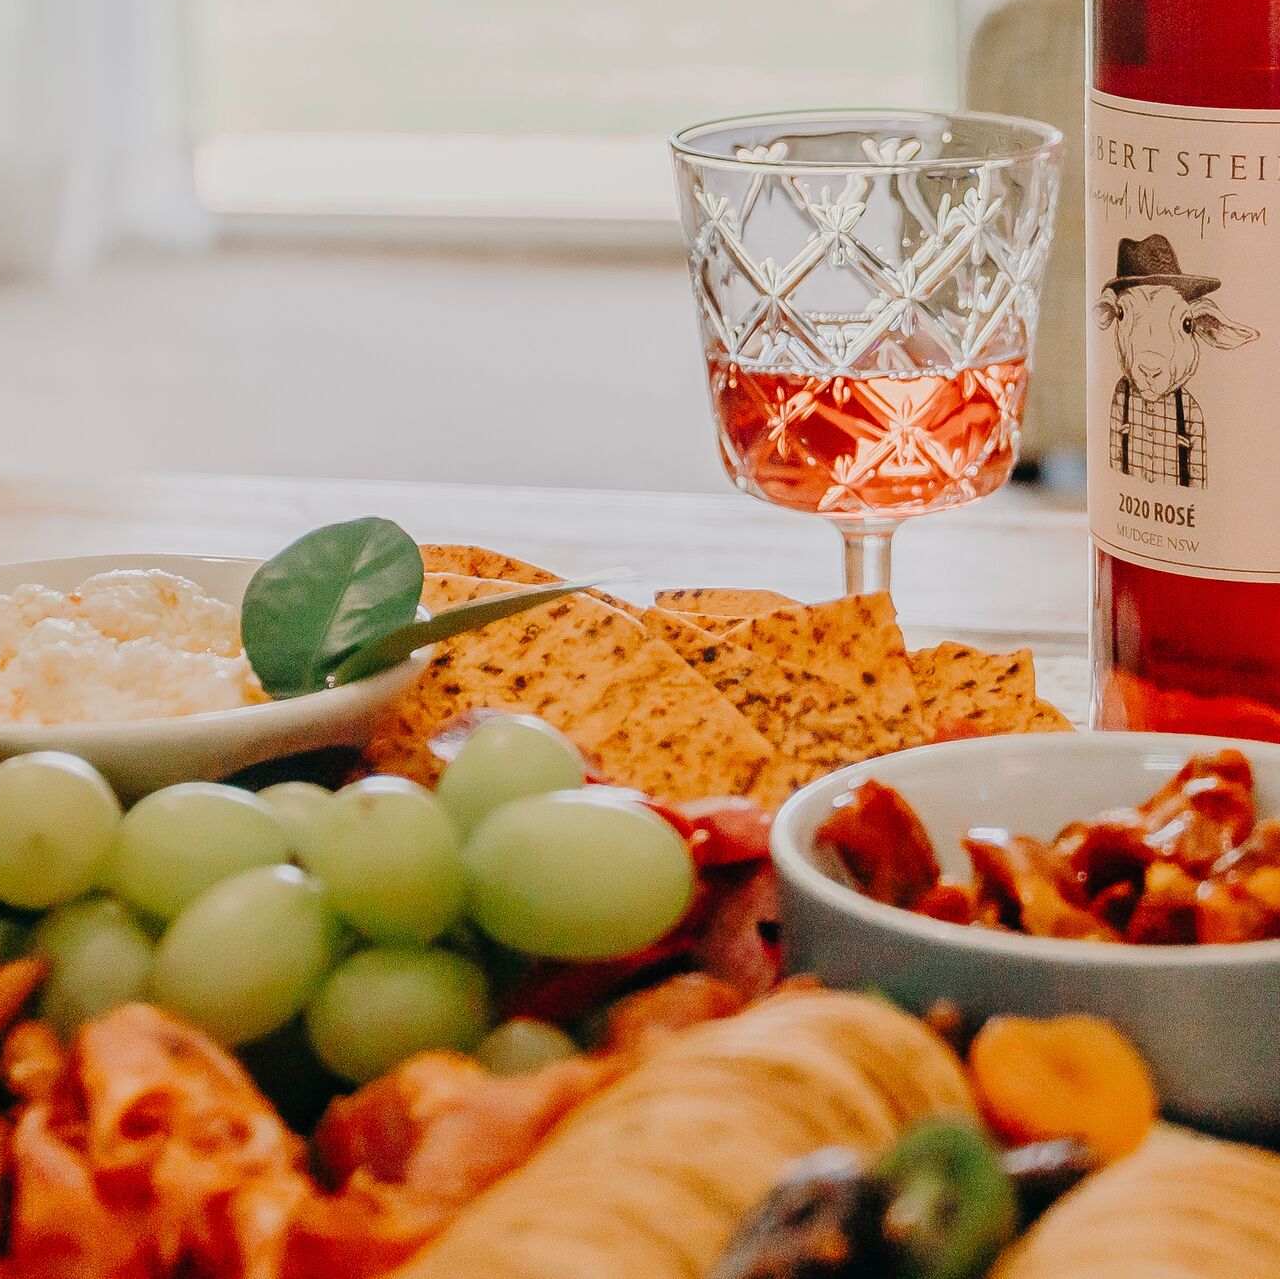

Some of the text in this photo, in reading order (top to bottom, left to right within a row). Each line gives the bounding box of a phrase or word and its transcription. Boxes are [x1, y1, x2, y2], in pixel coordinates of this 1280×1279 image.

[1137, 184, 1211, 239] Winery,
[1219, 192, 1268, 227] Farm
[1118, 493, 1196, 528] 2020 ROSÉ
[1116, 524, 1200, 553] MUDGEE NSW
